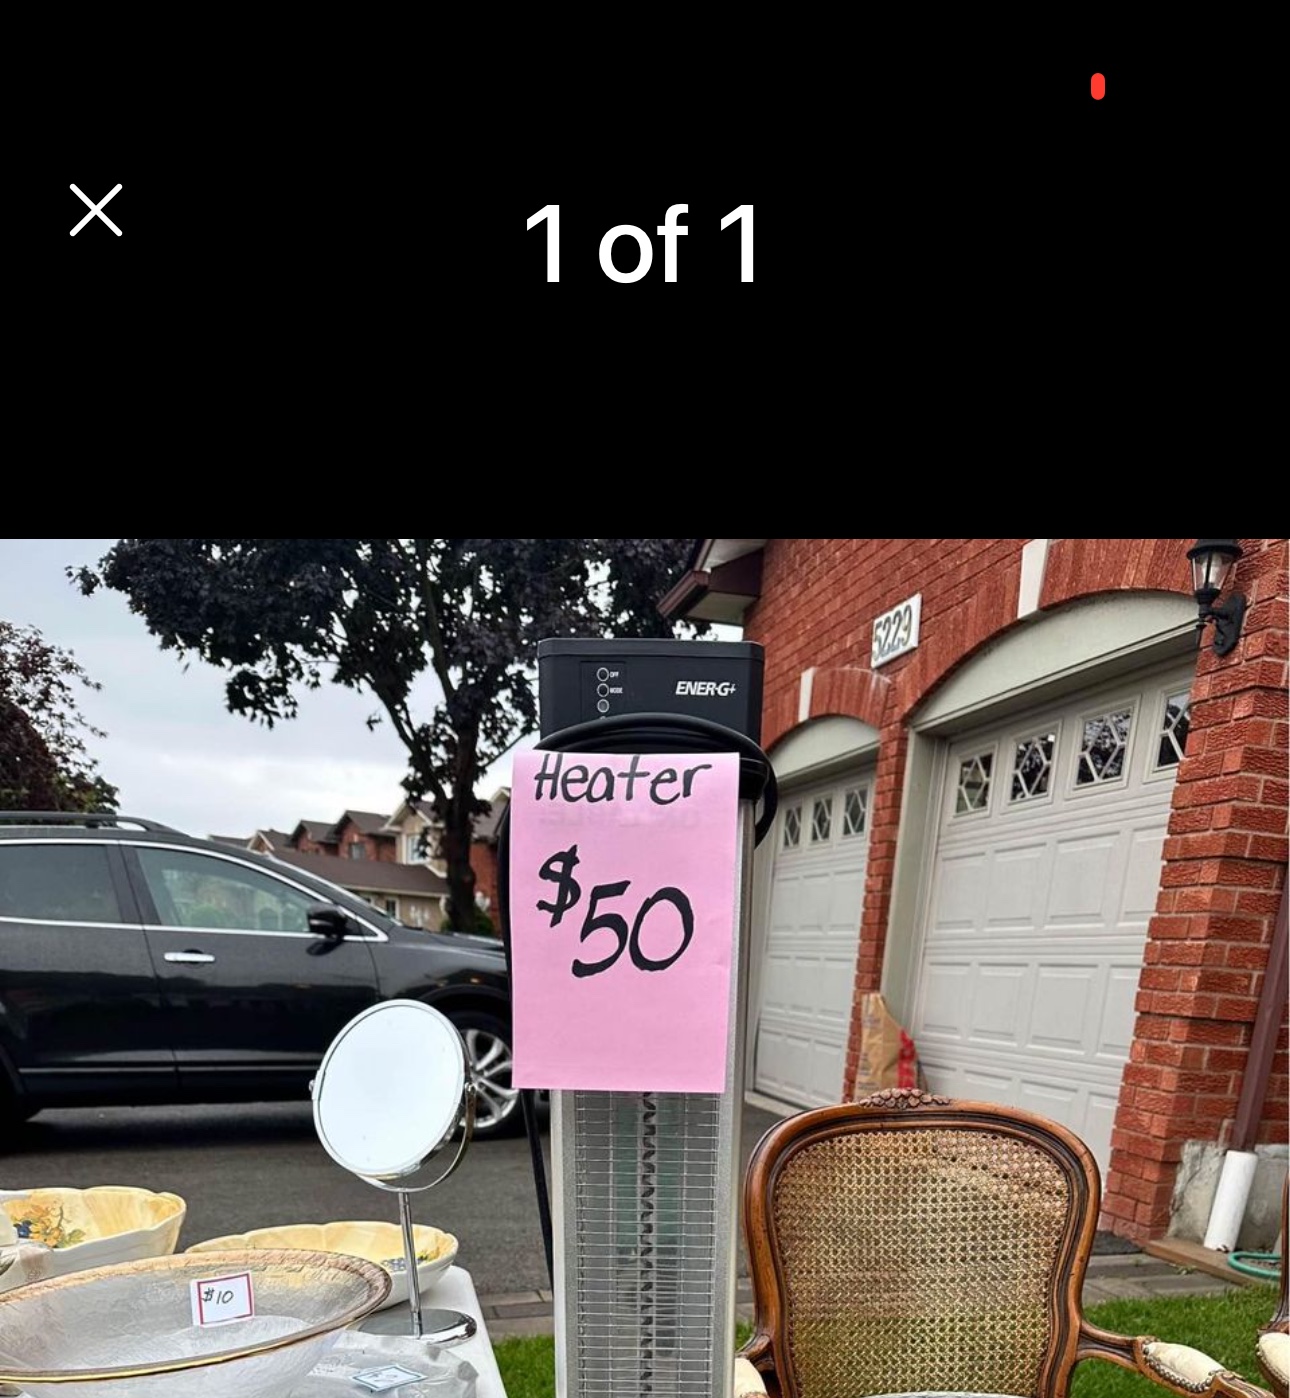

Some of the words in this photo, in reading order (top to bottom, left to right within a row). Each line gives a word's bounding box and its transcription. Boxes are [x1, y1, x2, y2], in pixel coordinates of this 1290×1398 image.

[874, 604, 912, 661] 5229
[534, 753, 712, 805] Heater
[536, 844, 694, 978] $50
[202, 1287, 234, 1305] $10
